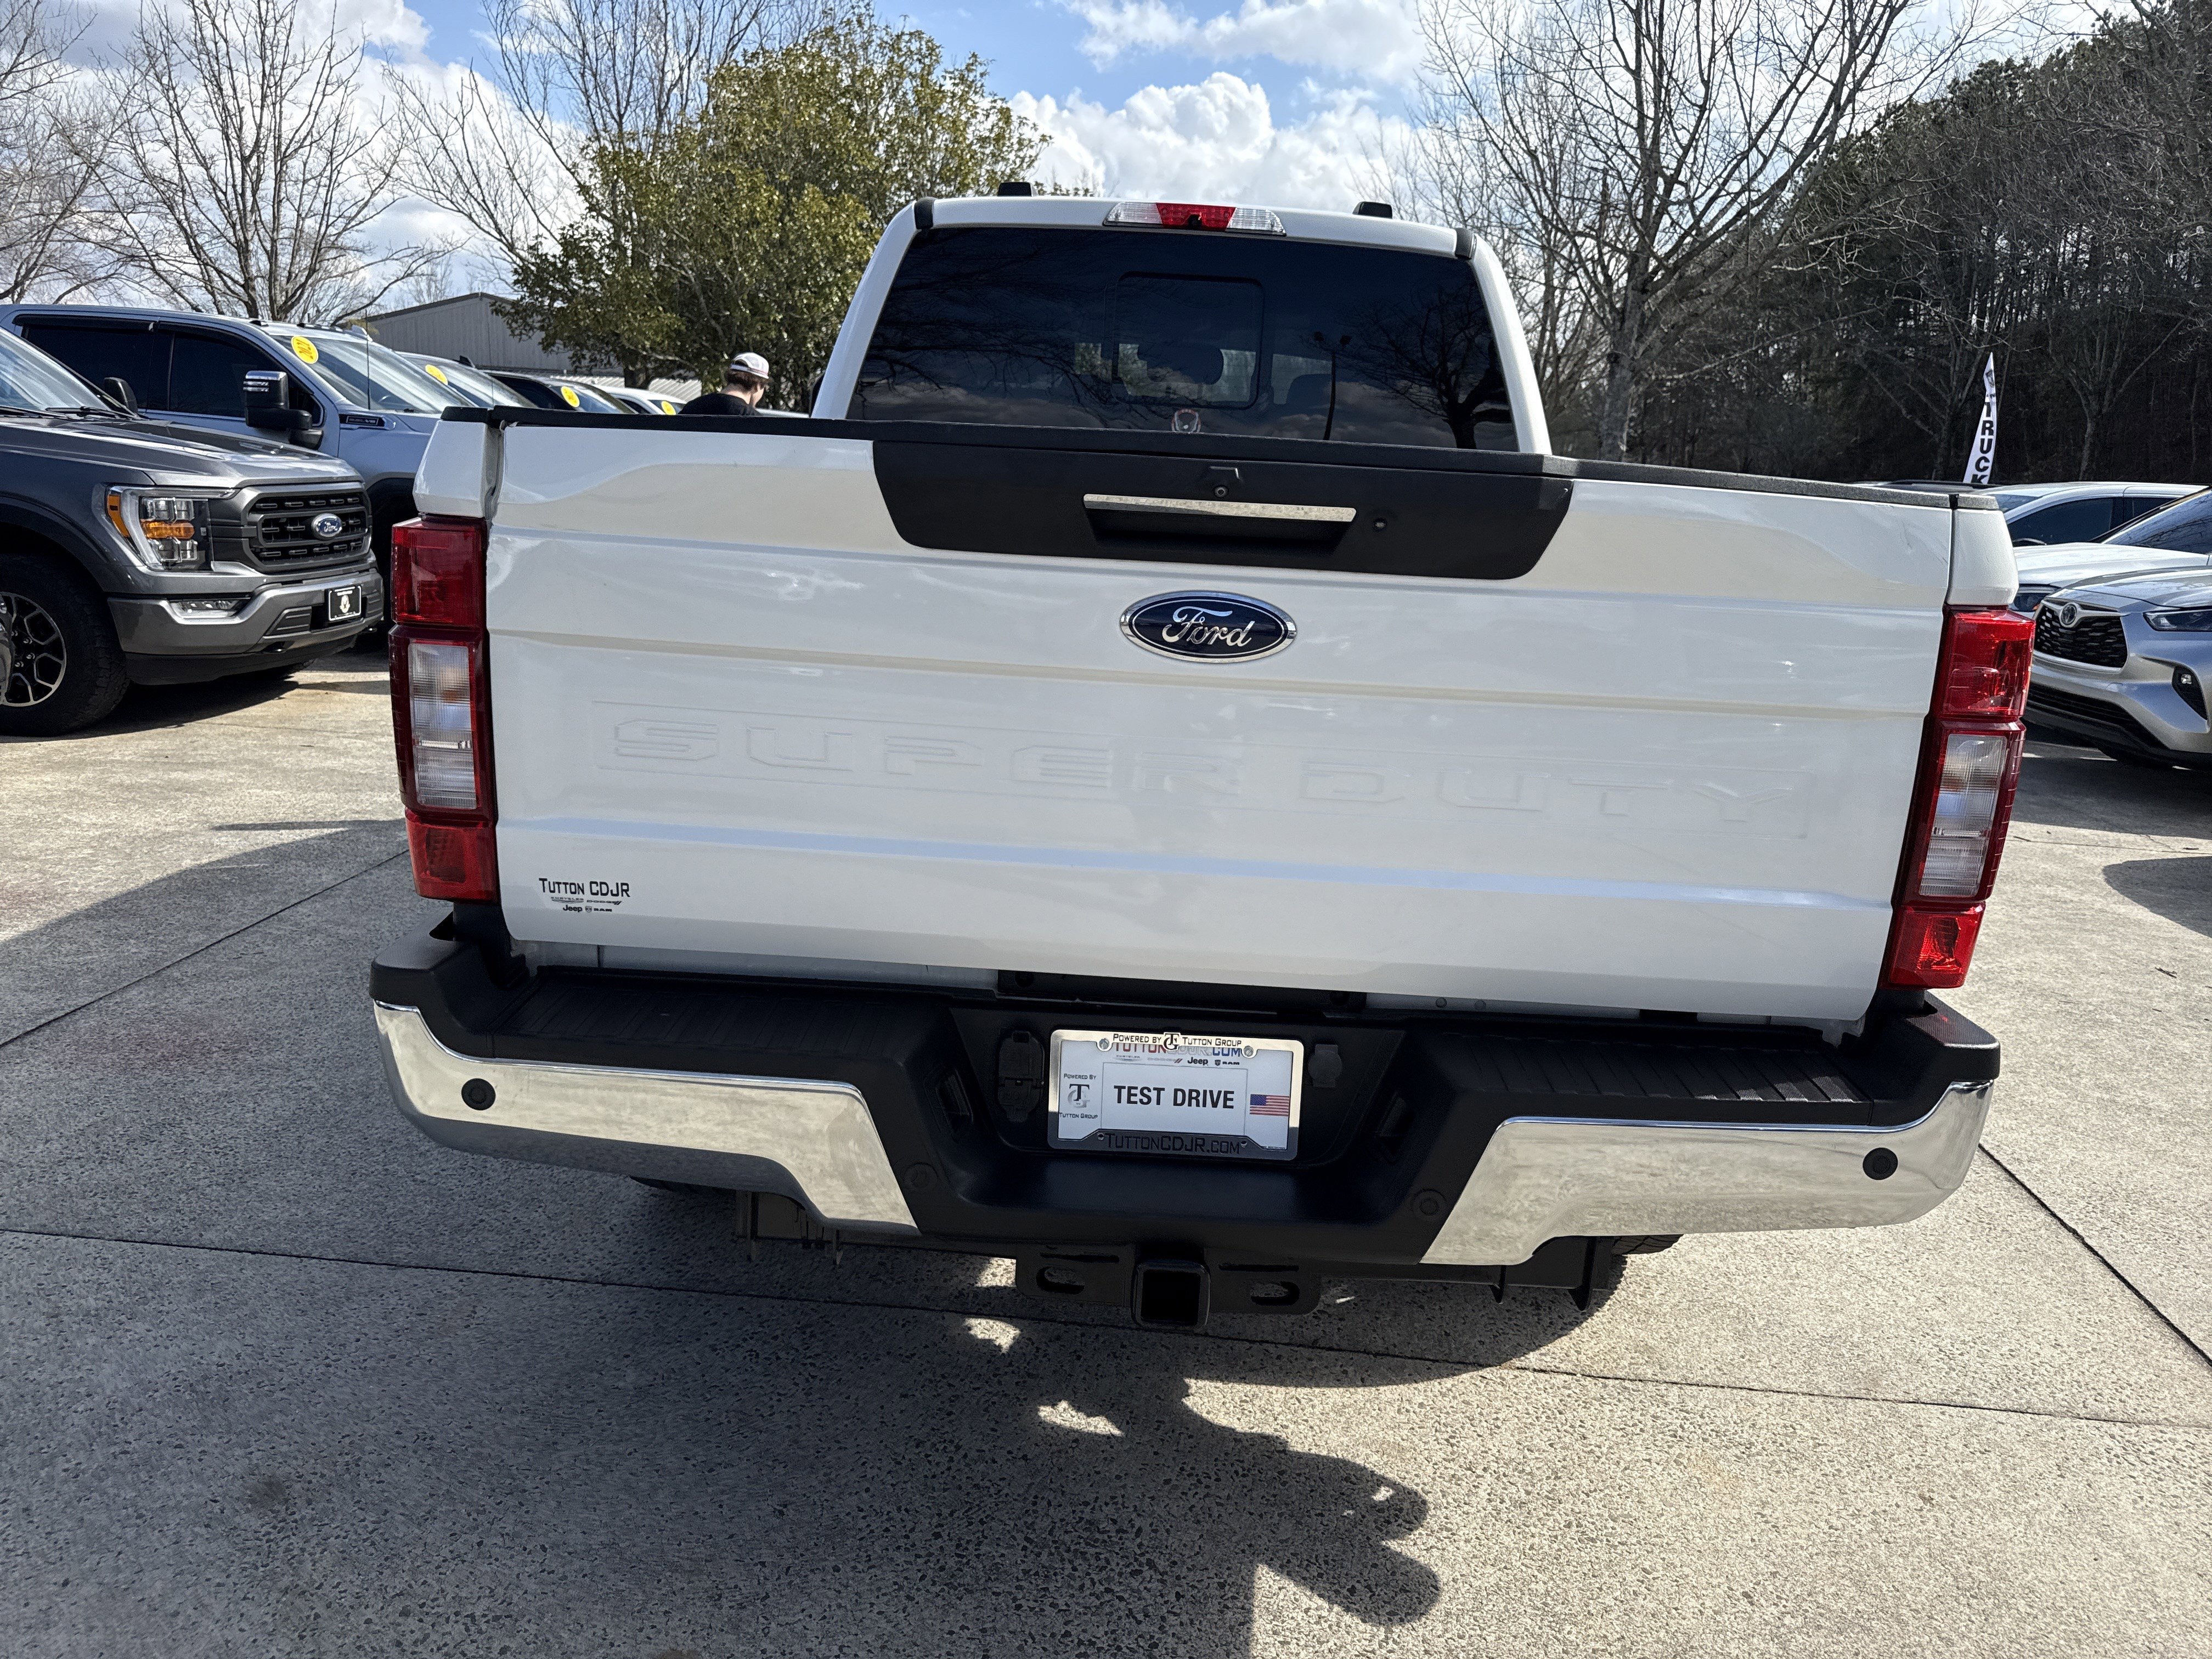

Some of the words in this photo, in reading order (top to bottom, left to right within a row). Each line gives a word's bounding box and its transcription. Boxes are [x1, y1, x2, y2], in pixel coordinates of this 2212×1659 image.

[1971, 402, 1994, 484] TRUCK
[1162, 606, 1255, 647] Ford
[613, 717, 1241, 797] SUPER
[1299, 760, 1795, 823] DUTY
[539, 878, 585, 895] TUTTON
[590, 881, 630, 897] CDJR
[1215, 1039, 1242, 1047] GROUP
[1188, 1057, 1209, 1065] Jeep
[1114, 1085, 1165, 1106] TEST
[1173, 1088, 1234, 1109] DRIVE
